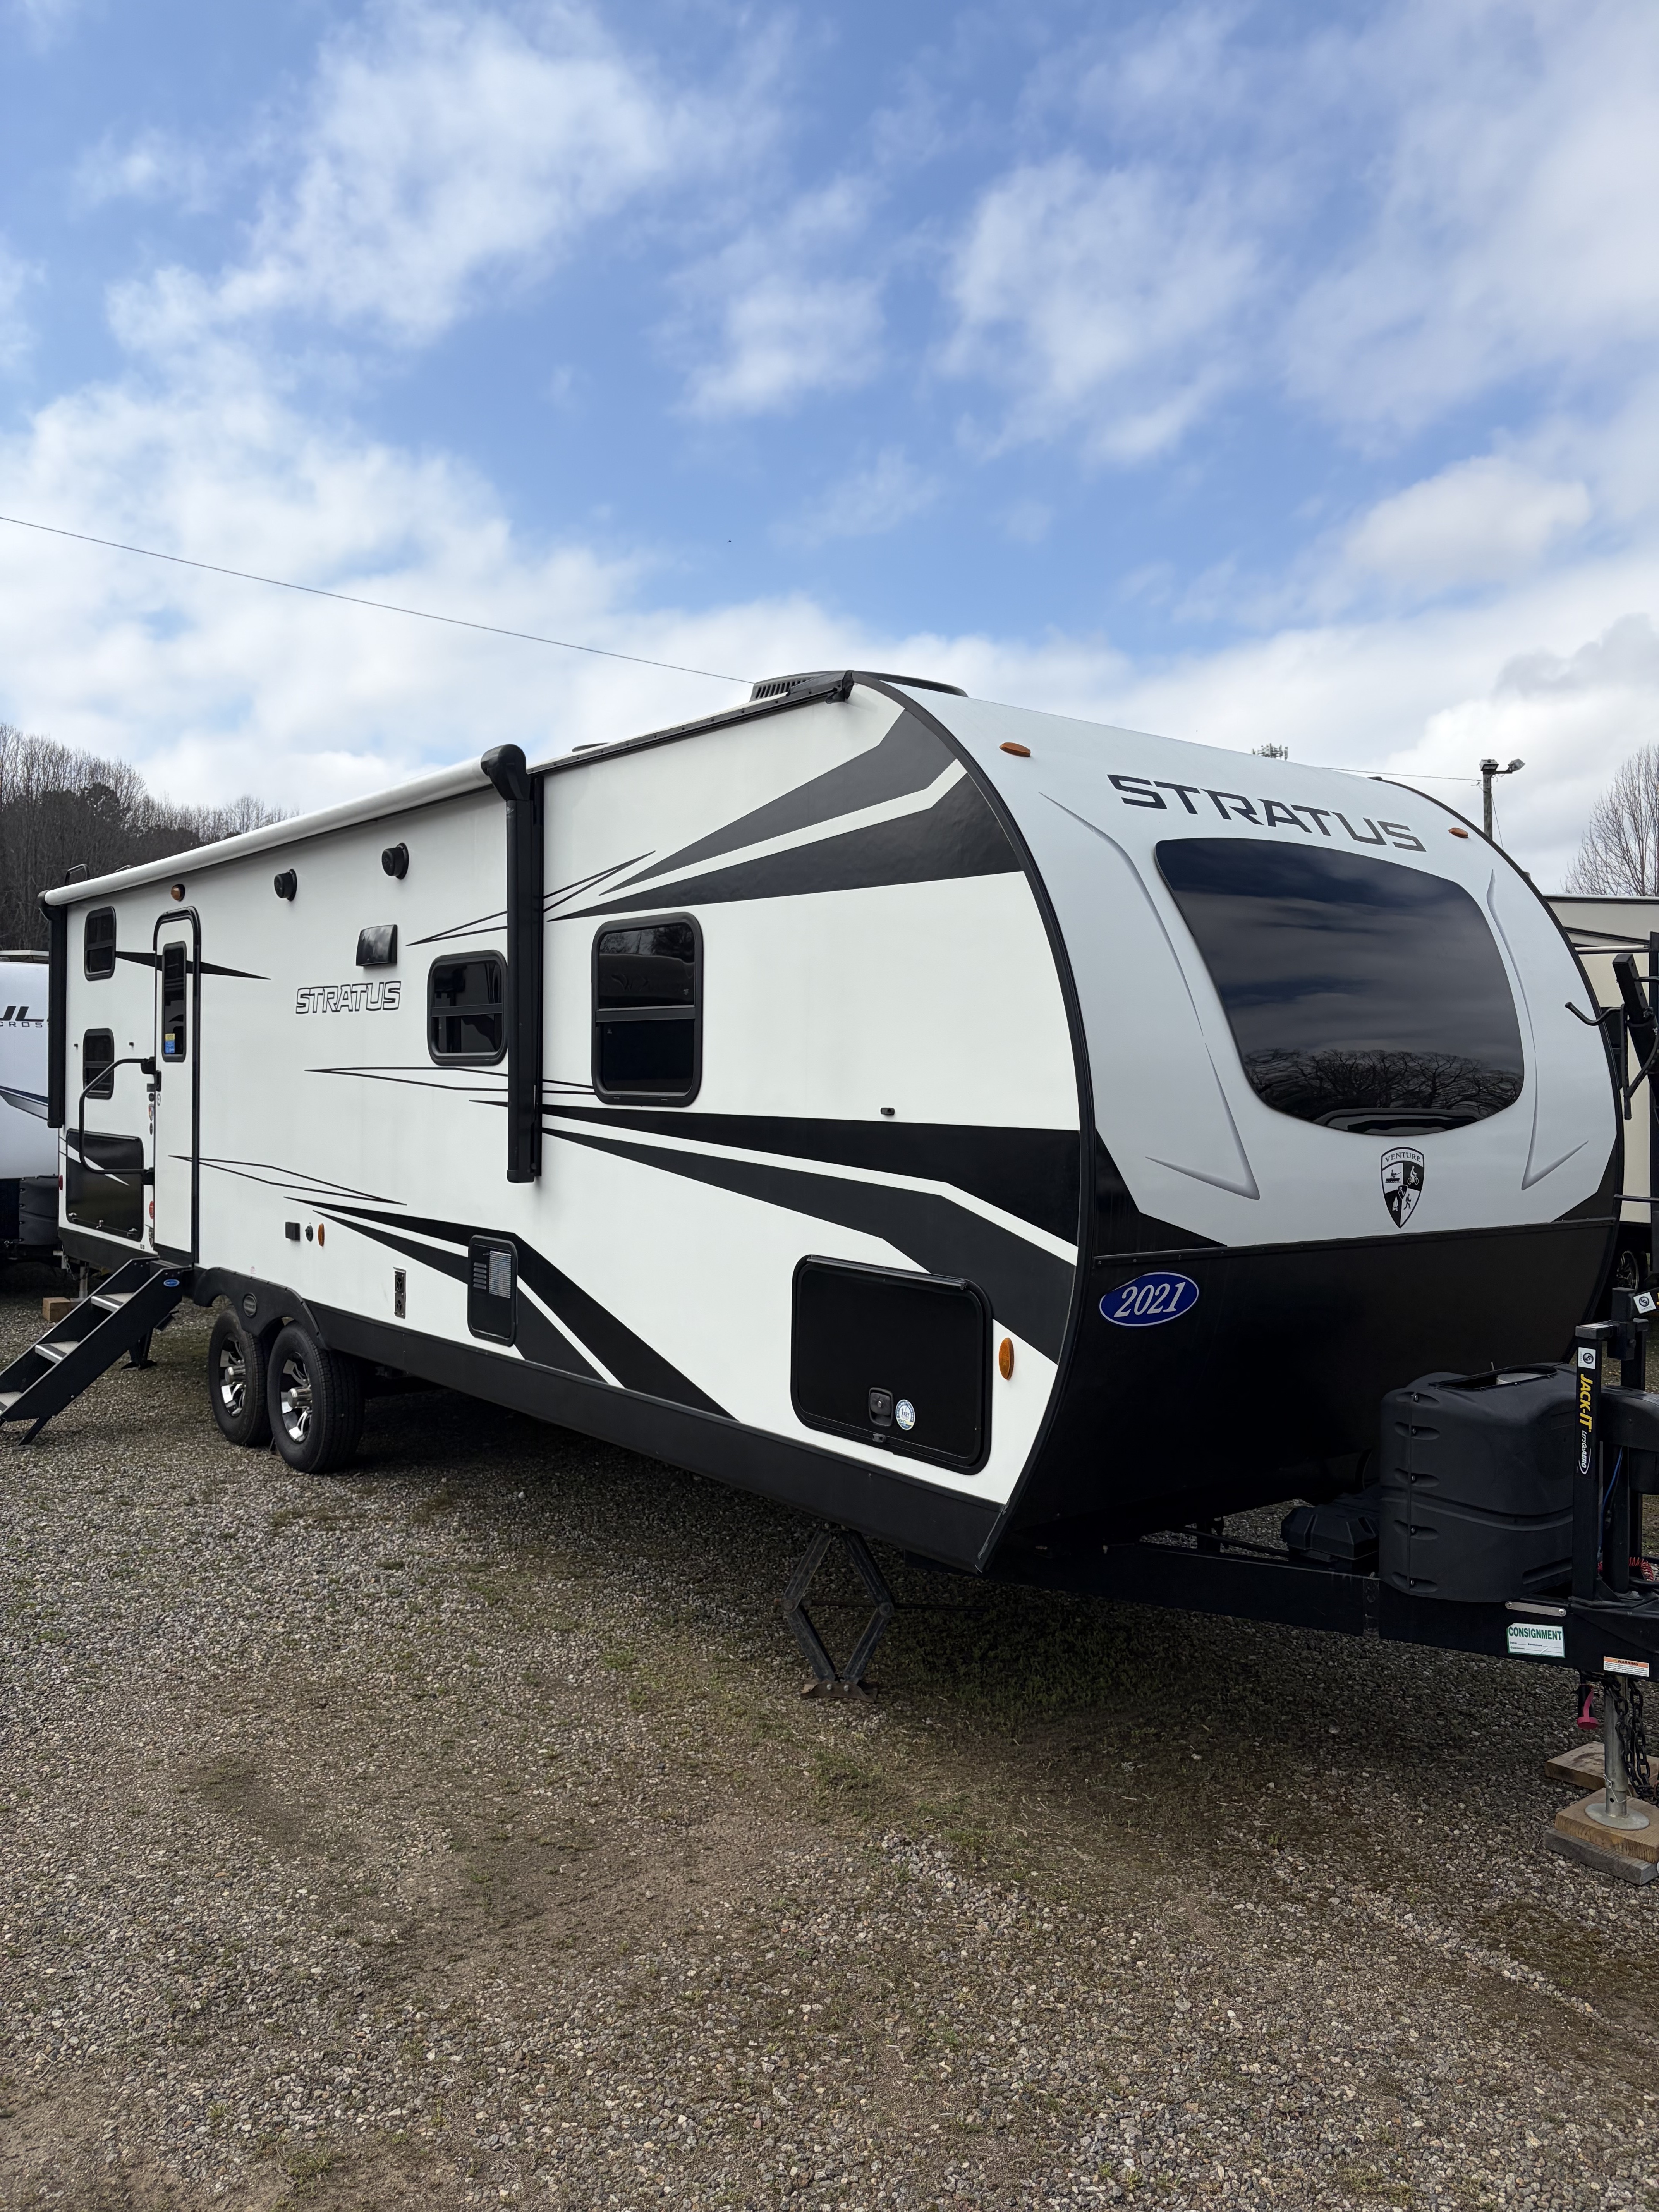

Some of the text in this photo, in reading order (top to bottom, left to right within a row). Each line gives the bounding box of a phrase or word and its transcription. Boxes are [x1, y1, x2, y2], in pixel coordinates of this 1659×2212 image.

[1107, 774, 1427, 852] STRATUS
[295, 981, 402, 1014] STRATUS
[1385, 1152, 1421, 1163] VENTURE
[1113, 1282, 1186, 1317] 2021
[1508, 1626, 1562, 1640] CONSIGNMENT
